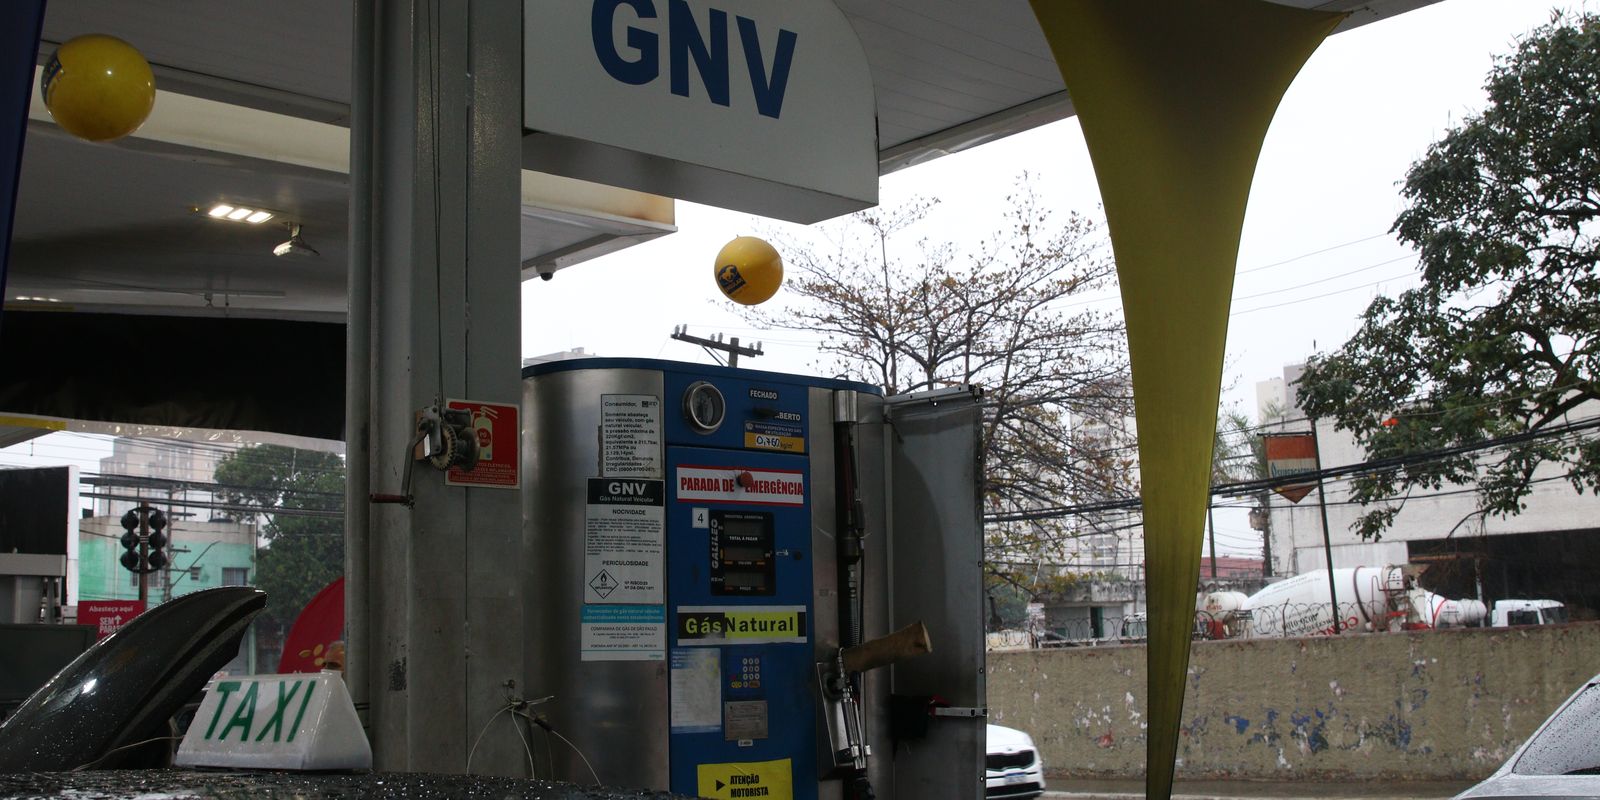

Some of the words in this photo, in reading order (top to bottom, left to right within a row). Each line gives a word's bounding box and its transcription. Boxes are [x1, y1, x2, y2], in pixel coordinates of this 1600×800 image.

[591, 0, 798, 120] GNV
[750, 390, 778, 400] FECHADO
[608, 482, 646, 495] GNV
[680, 477, 720, 492] PARADA
[722, 479, 734, 492] DE
[698, 513, 704, 523] 4
[204, 680, 316, 742] TAXI
[730, 774, 760, 785] ATENÇÃO
[730, 786, 769, 798] MOTORISTA
